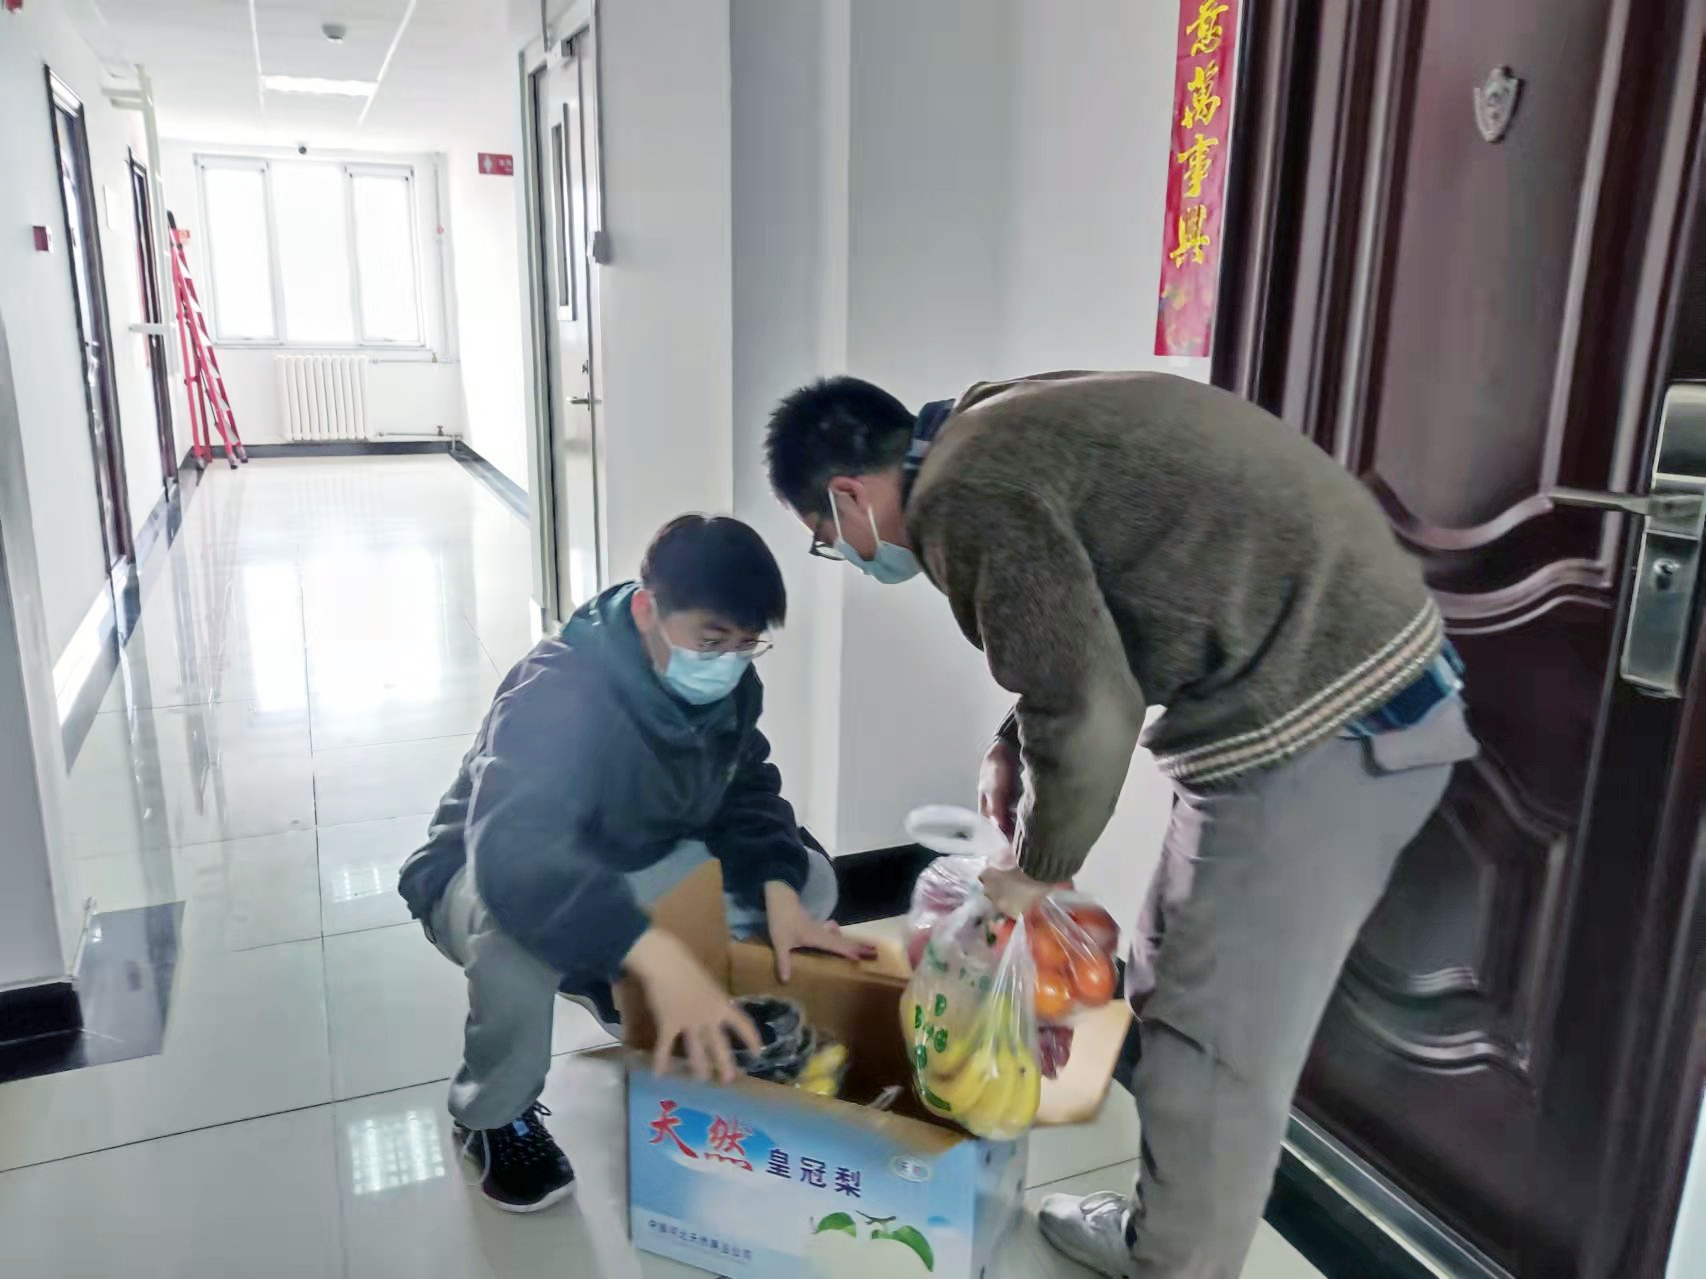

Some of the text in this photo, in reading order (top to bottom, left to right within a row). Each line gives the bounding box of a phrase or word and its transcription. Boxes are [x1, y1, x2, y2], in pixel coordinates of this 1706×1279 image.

[650, 1100, 753, 1172] 天然
[766, 1148, 862, 1198] 皇冠梨
